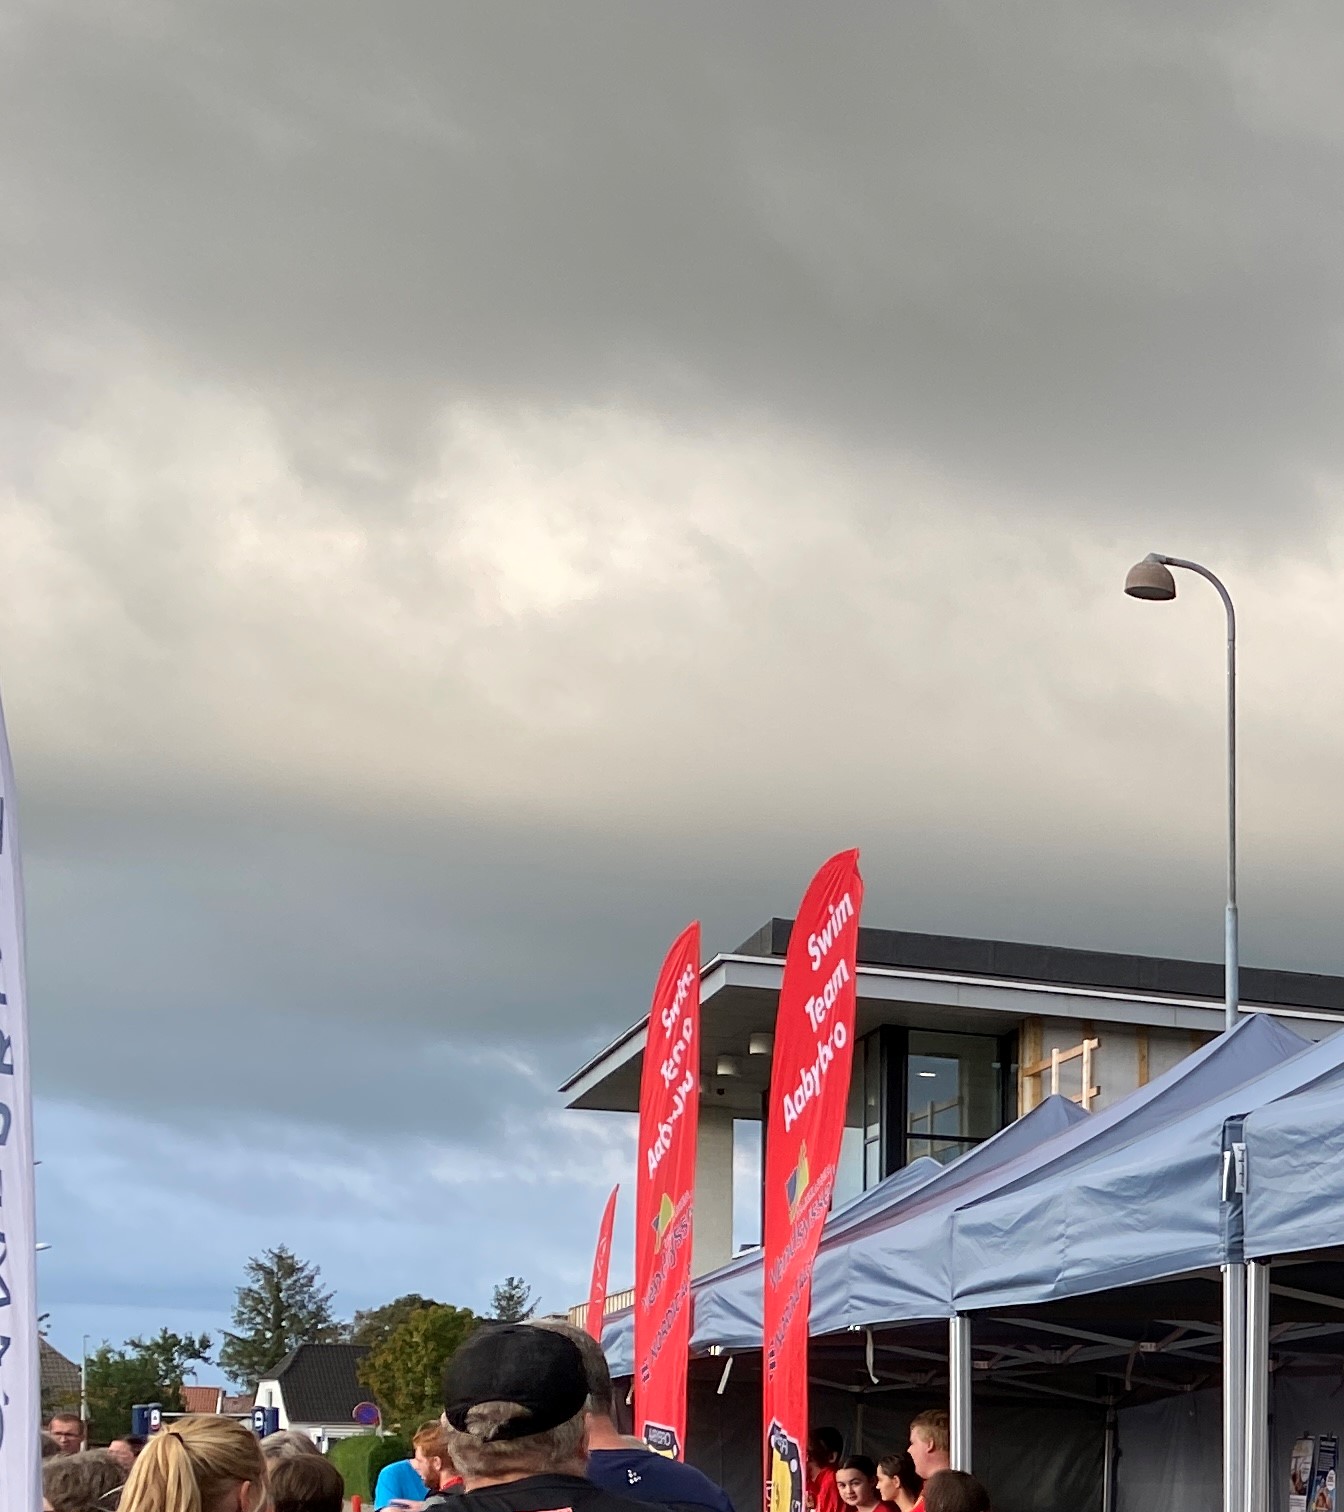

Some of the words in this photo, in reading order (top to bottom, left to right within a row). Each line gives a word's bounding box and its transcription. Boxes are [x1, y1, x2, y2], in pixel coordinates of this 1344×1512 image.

[807, 891, 855, 971] Swim
[805, 958, 850, 1032] Team
[782, 1021, 847, 1132] Aabybro
